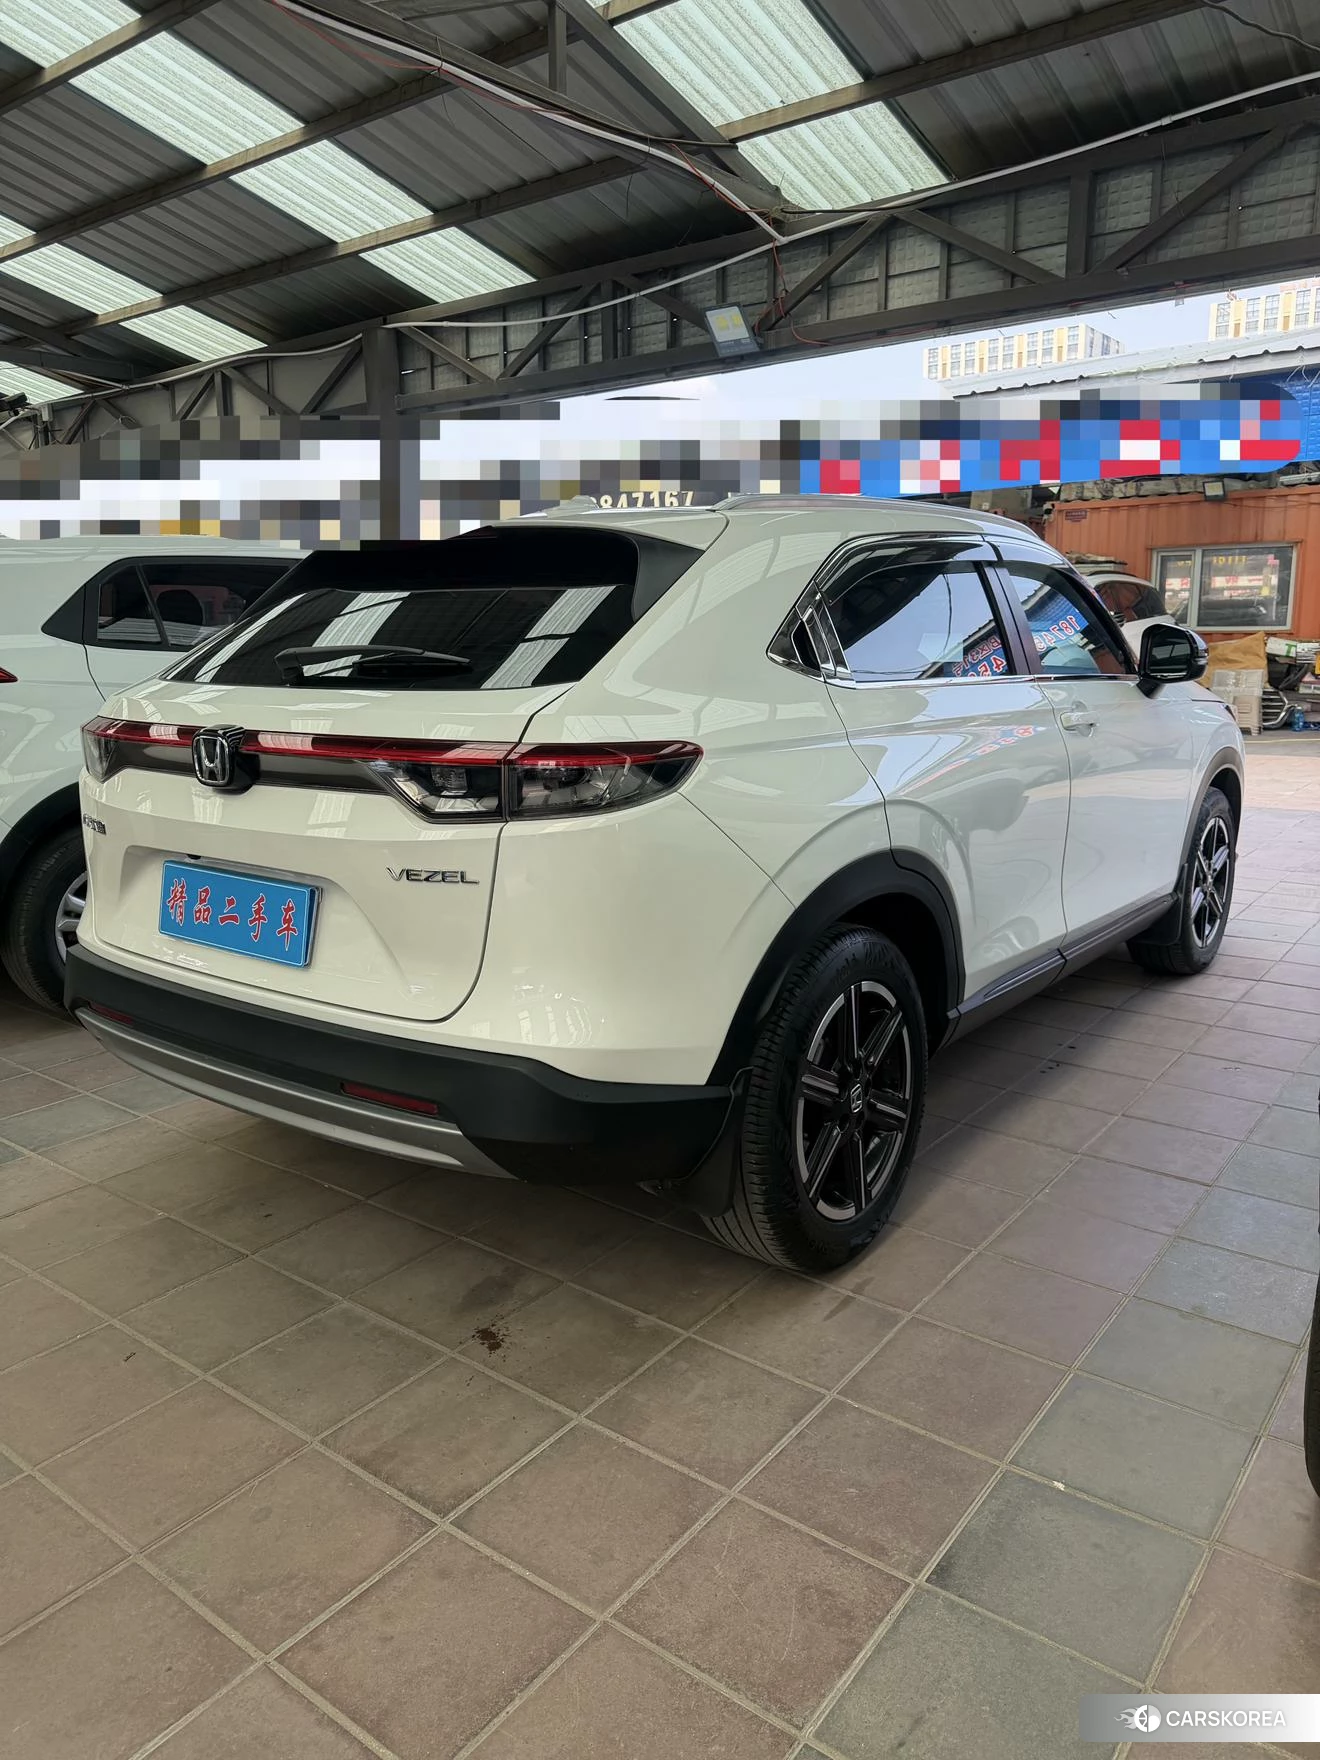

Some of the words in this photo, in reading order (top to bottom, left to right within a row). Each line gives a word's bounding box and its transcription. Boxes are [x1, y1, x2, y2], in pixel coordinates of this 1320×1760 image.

[385, 866, 480, 884] VEZEL
[166, 877, 299, 952] 精品二手车
